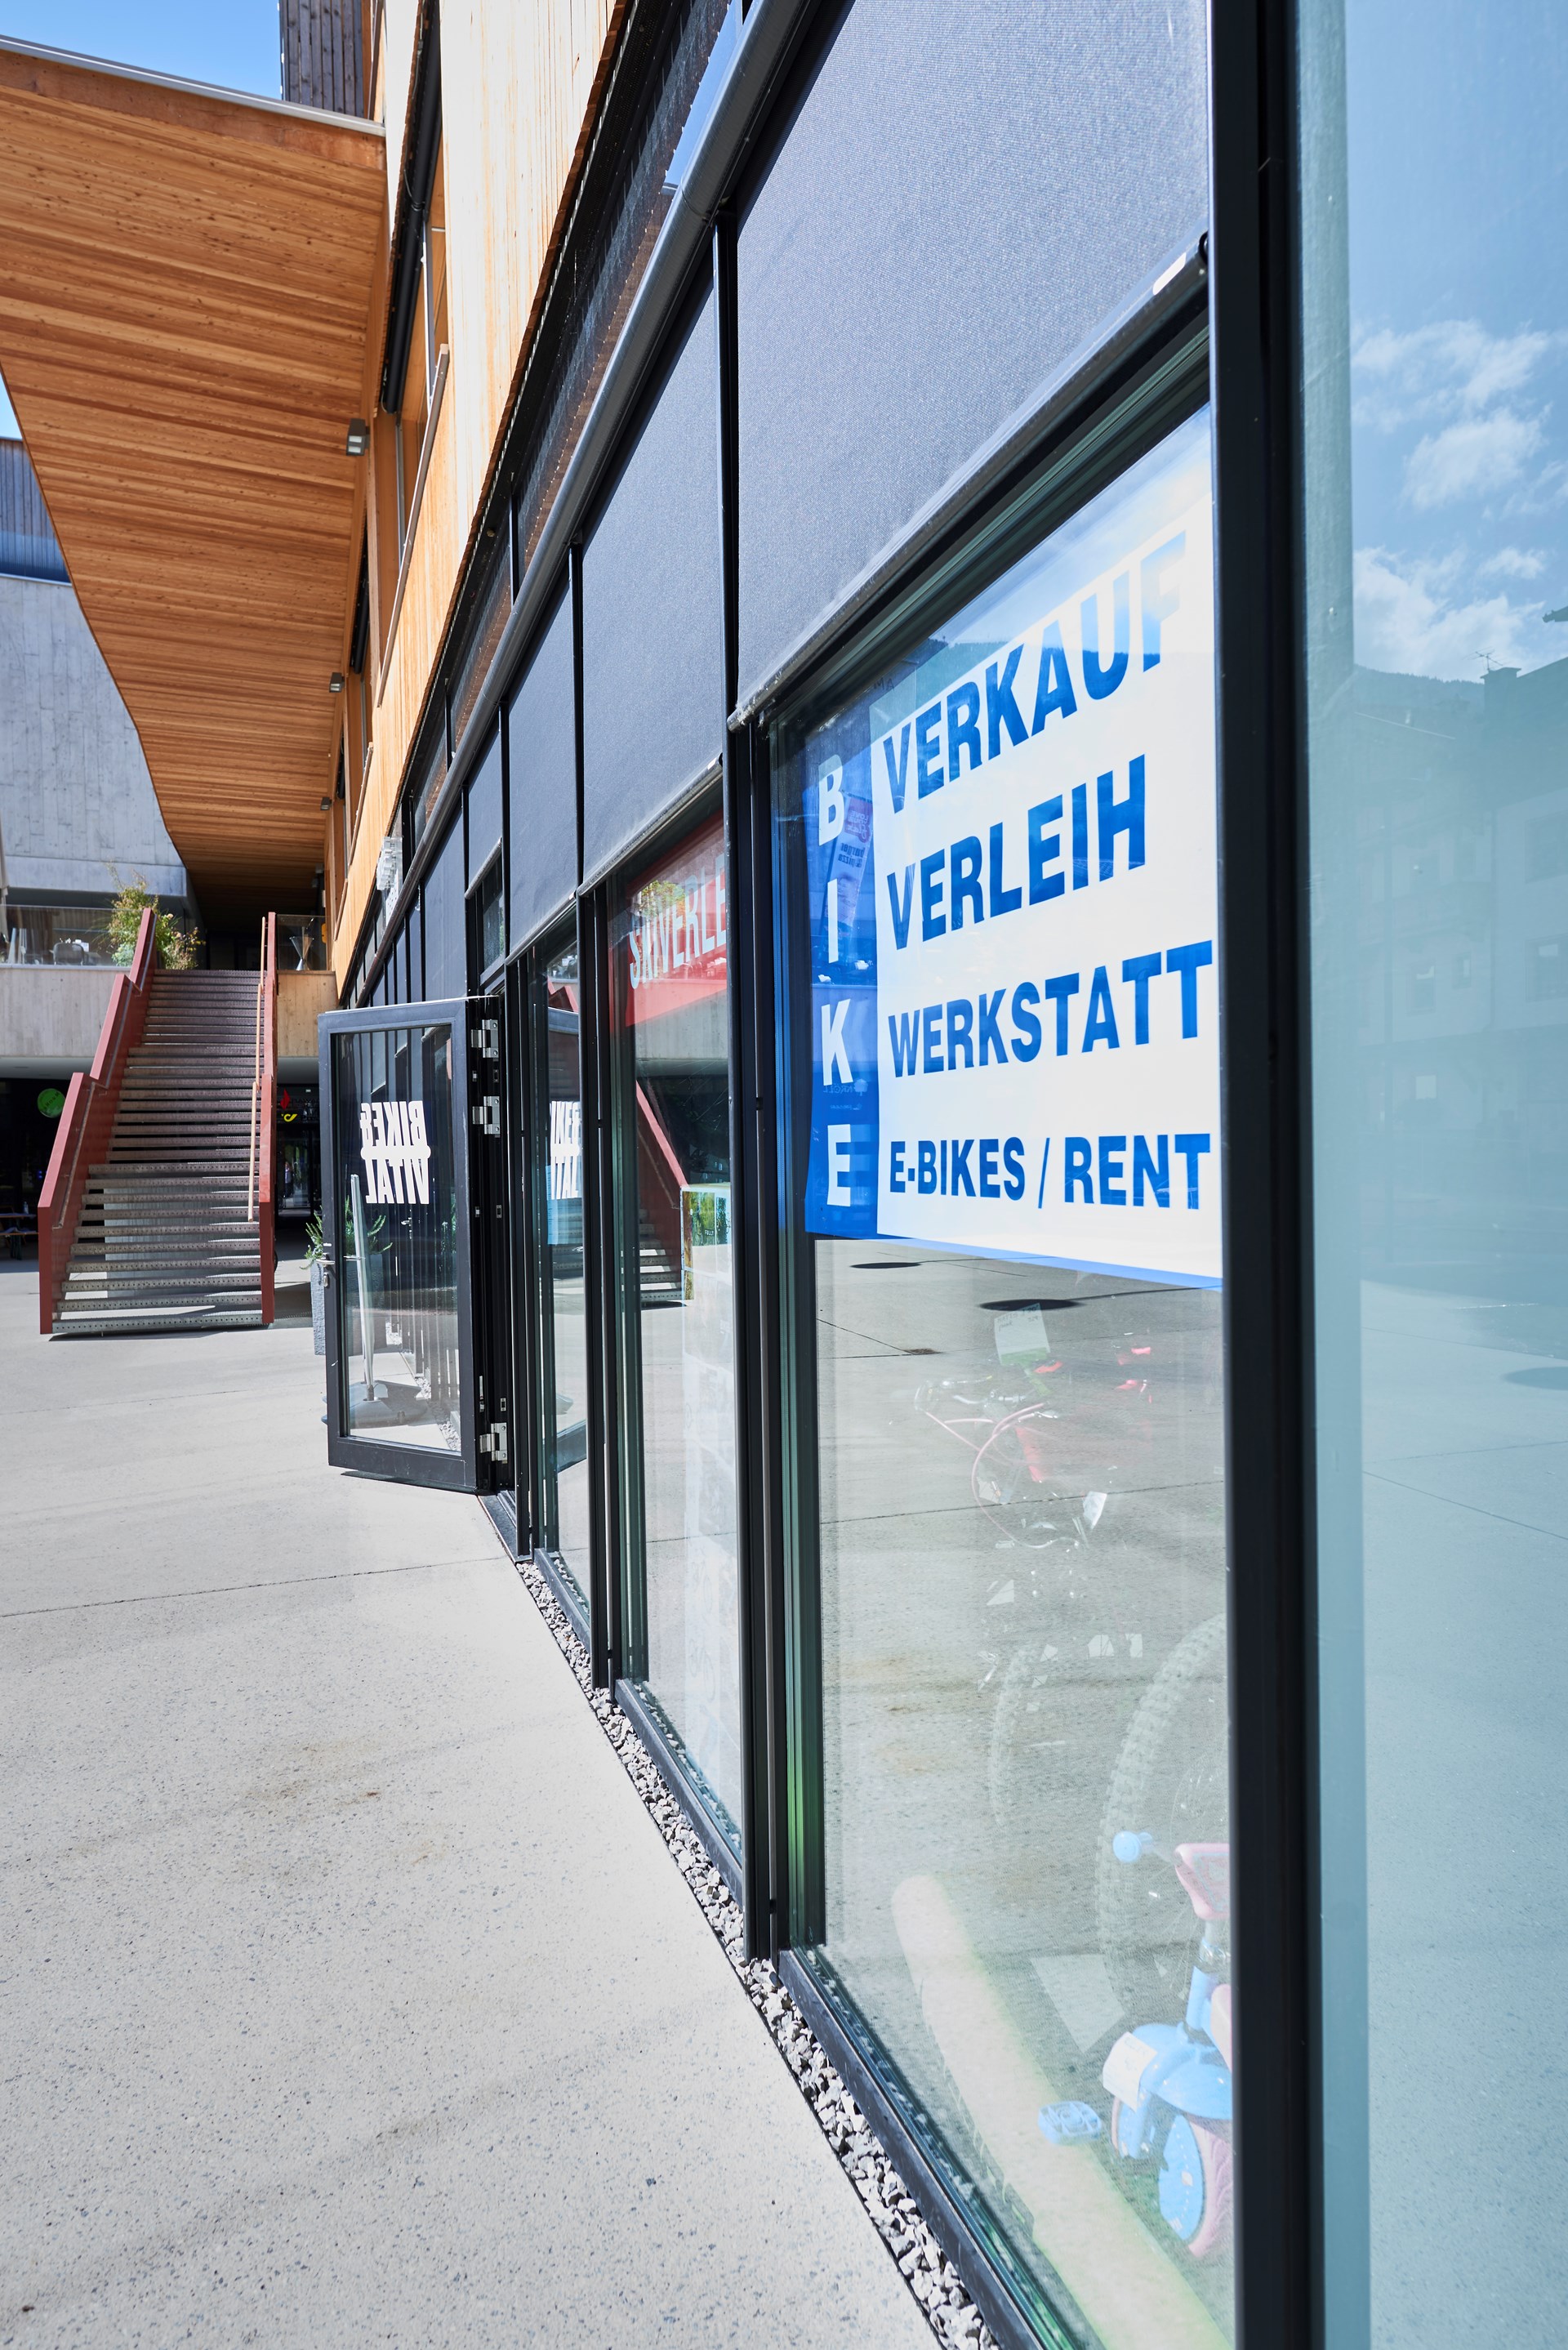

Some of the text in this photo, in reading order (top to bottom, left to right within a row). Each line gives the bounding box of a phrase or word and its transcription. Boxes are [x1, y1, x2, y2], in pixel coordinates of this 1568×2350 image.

[884, 530, 1186, 814] VERKAUF
[887, 754, 1146, 951] VERLEIH
[889, 940, 1213, 1078] WERKSTATT
[889, 1136, 1026, 1201] E-BIKES
[1064, 1133, 1211, 1210] RENT
